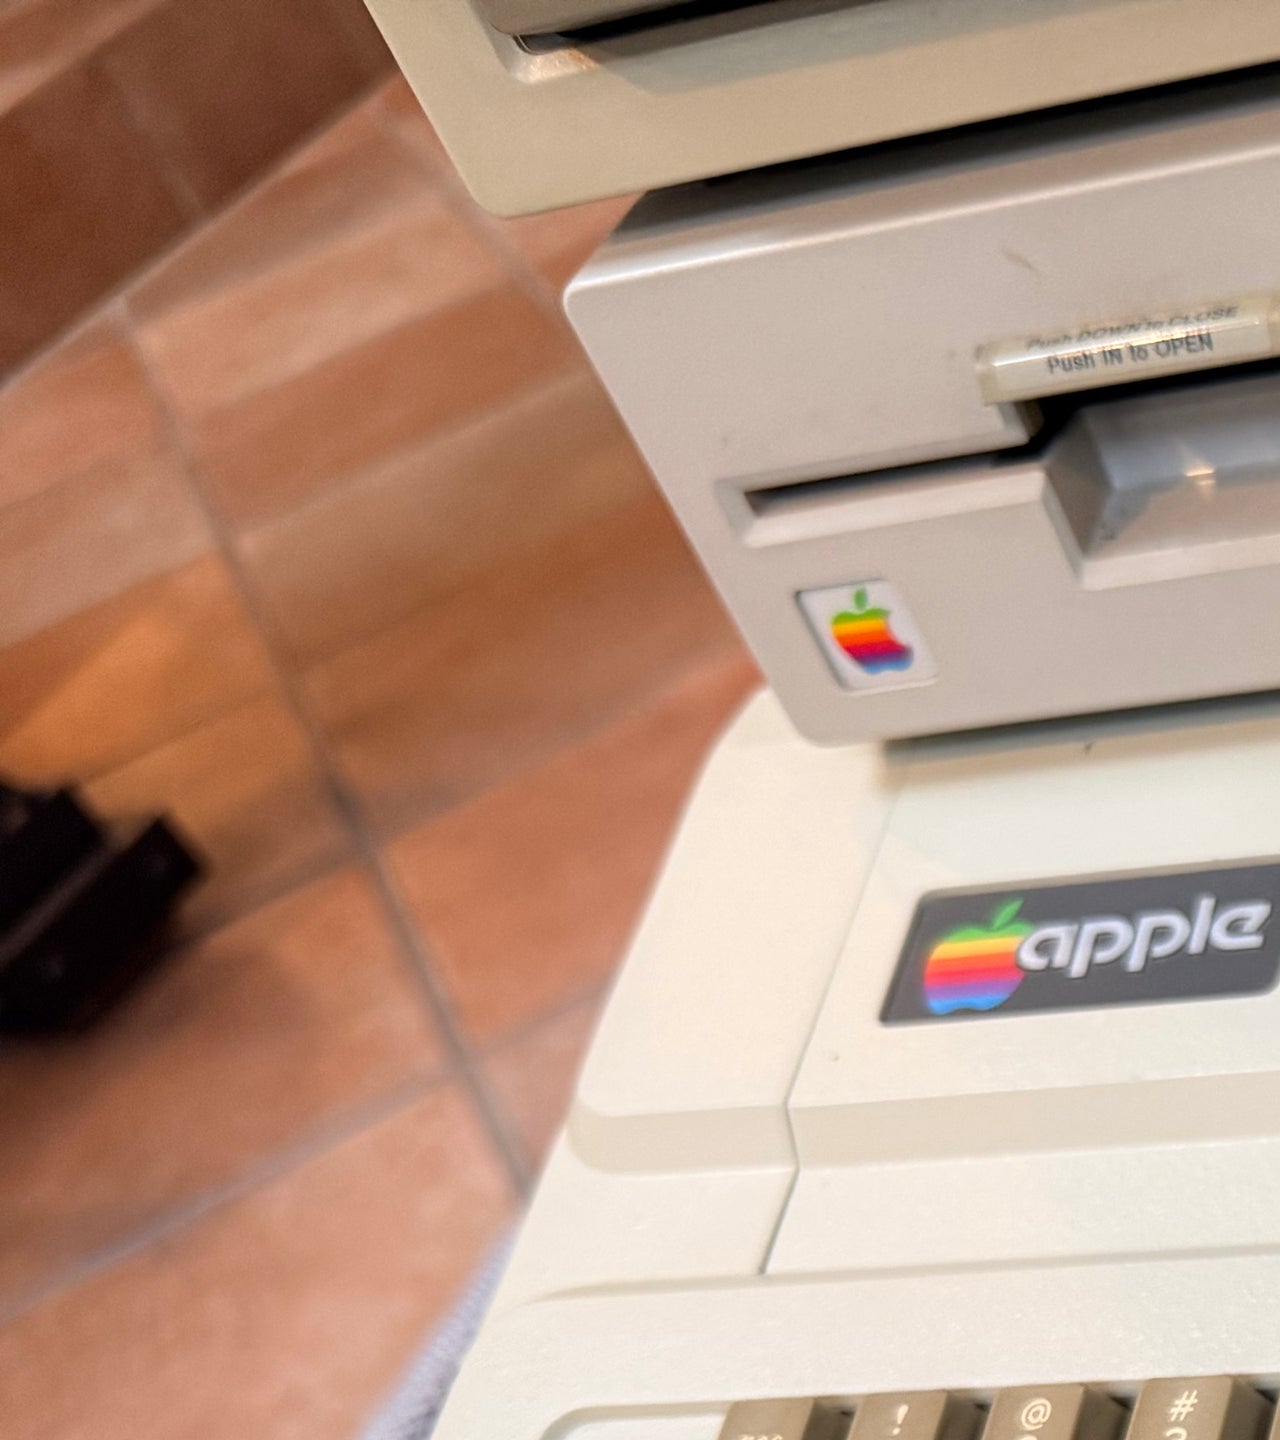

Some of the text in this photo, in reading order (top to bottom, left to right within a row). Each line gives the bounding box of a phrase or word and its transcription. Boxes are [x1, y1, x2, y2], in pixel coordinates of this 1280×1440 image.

[1047, 352, 1096, 373] Push
[1155, 331, 1214, 358] OPEN
[1016, 895, 1273, 978] apple
[1021, 1398, 1052, 1431] @
[1169, 1390, 1199, 1422] #
